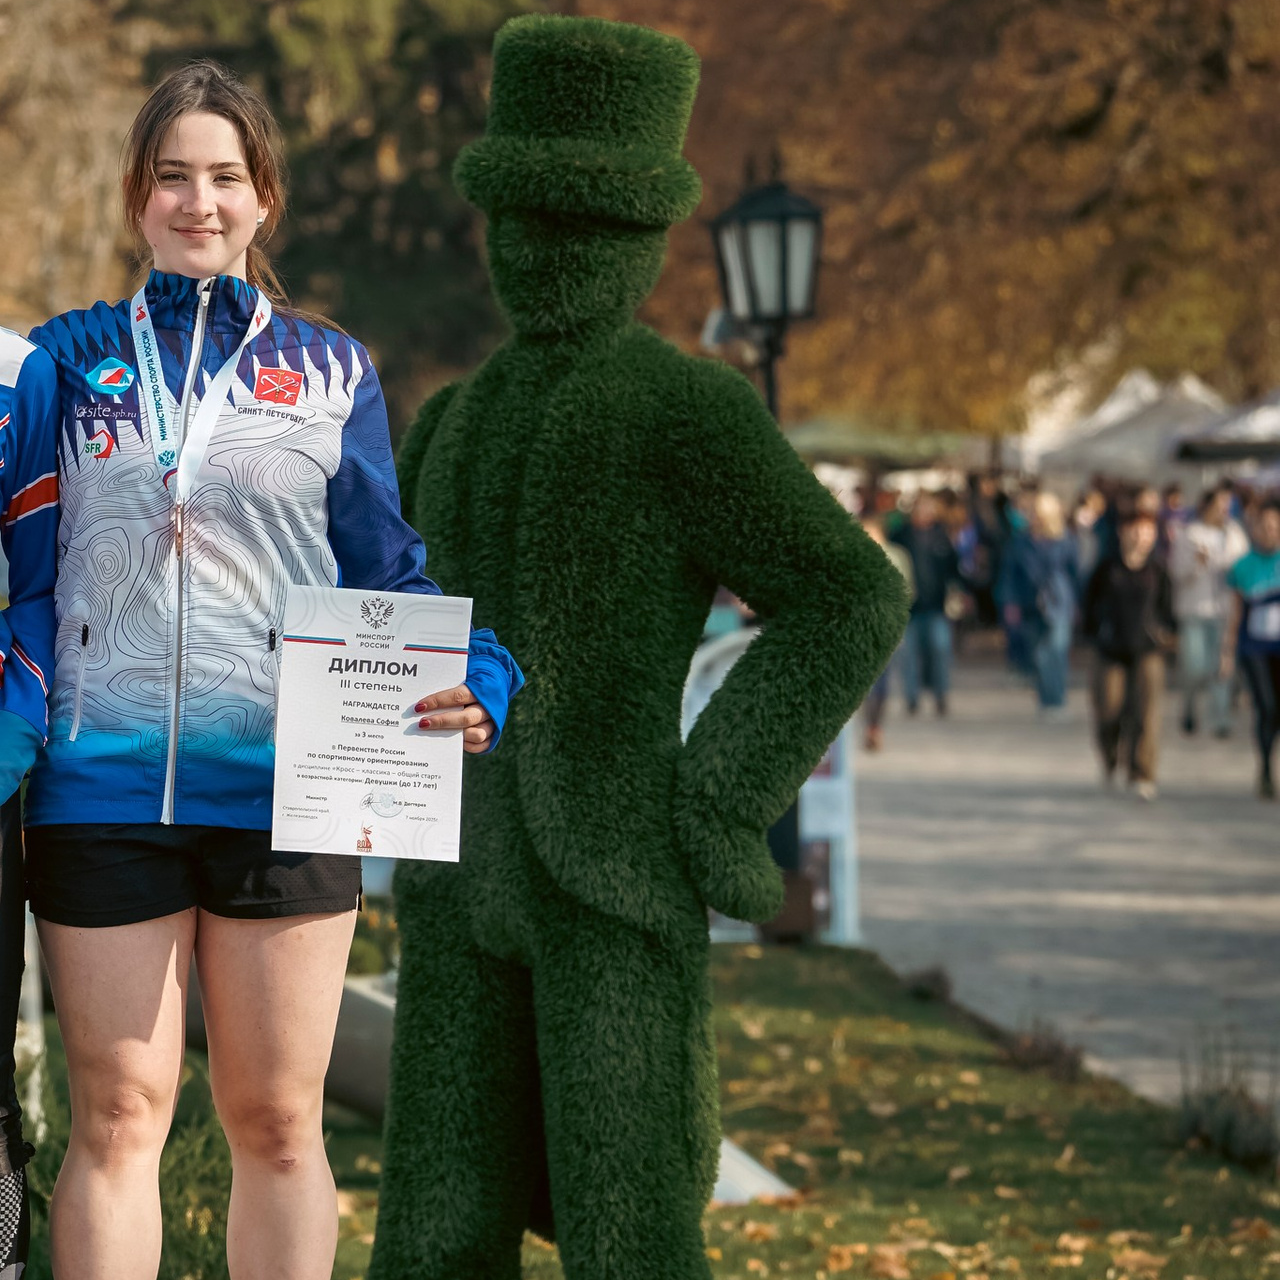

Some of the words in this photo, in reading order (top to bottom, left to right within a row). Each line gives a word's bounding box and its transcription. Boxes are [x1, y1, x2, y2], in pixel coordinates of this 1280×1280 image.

[142, 330, 152, 358] РОССИИ
[147, 358, 158, 383] СПОРТА
[152, 385, 167, 441] МИНИСТЕРСТВО
[85, 443, 101, 453] SFR
[355, 633, 395, 641] МИНСПОРТ
[359, 641, 389, 649] РОССИИ
[328, 657, 417, 678] ДИПЛОМ
[353, 681, 402, 692] степень
[342, 700, 399, 711] НАГРАЖДАЕТСЯ
[340, 715, 374, 724] Ковалева
[375, 718, 399, 727] София
[337, 744, 378, 753] Первенстве
[380, 747, 405, 755] России
[318, 753, 365, 763] спортивному
[366, 757, 429, 768] ориентированию
[397, 770, 419, 778] общий
[301, 773, 333, 781] возрастной
[364, 777, 397, 787] Девушки
[399, 780, 411, 788] (до
